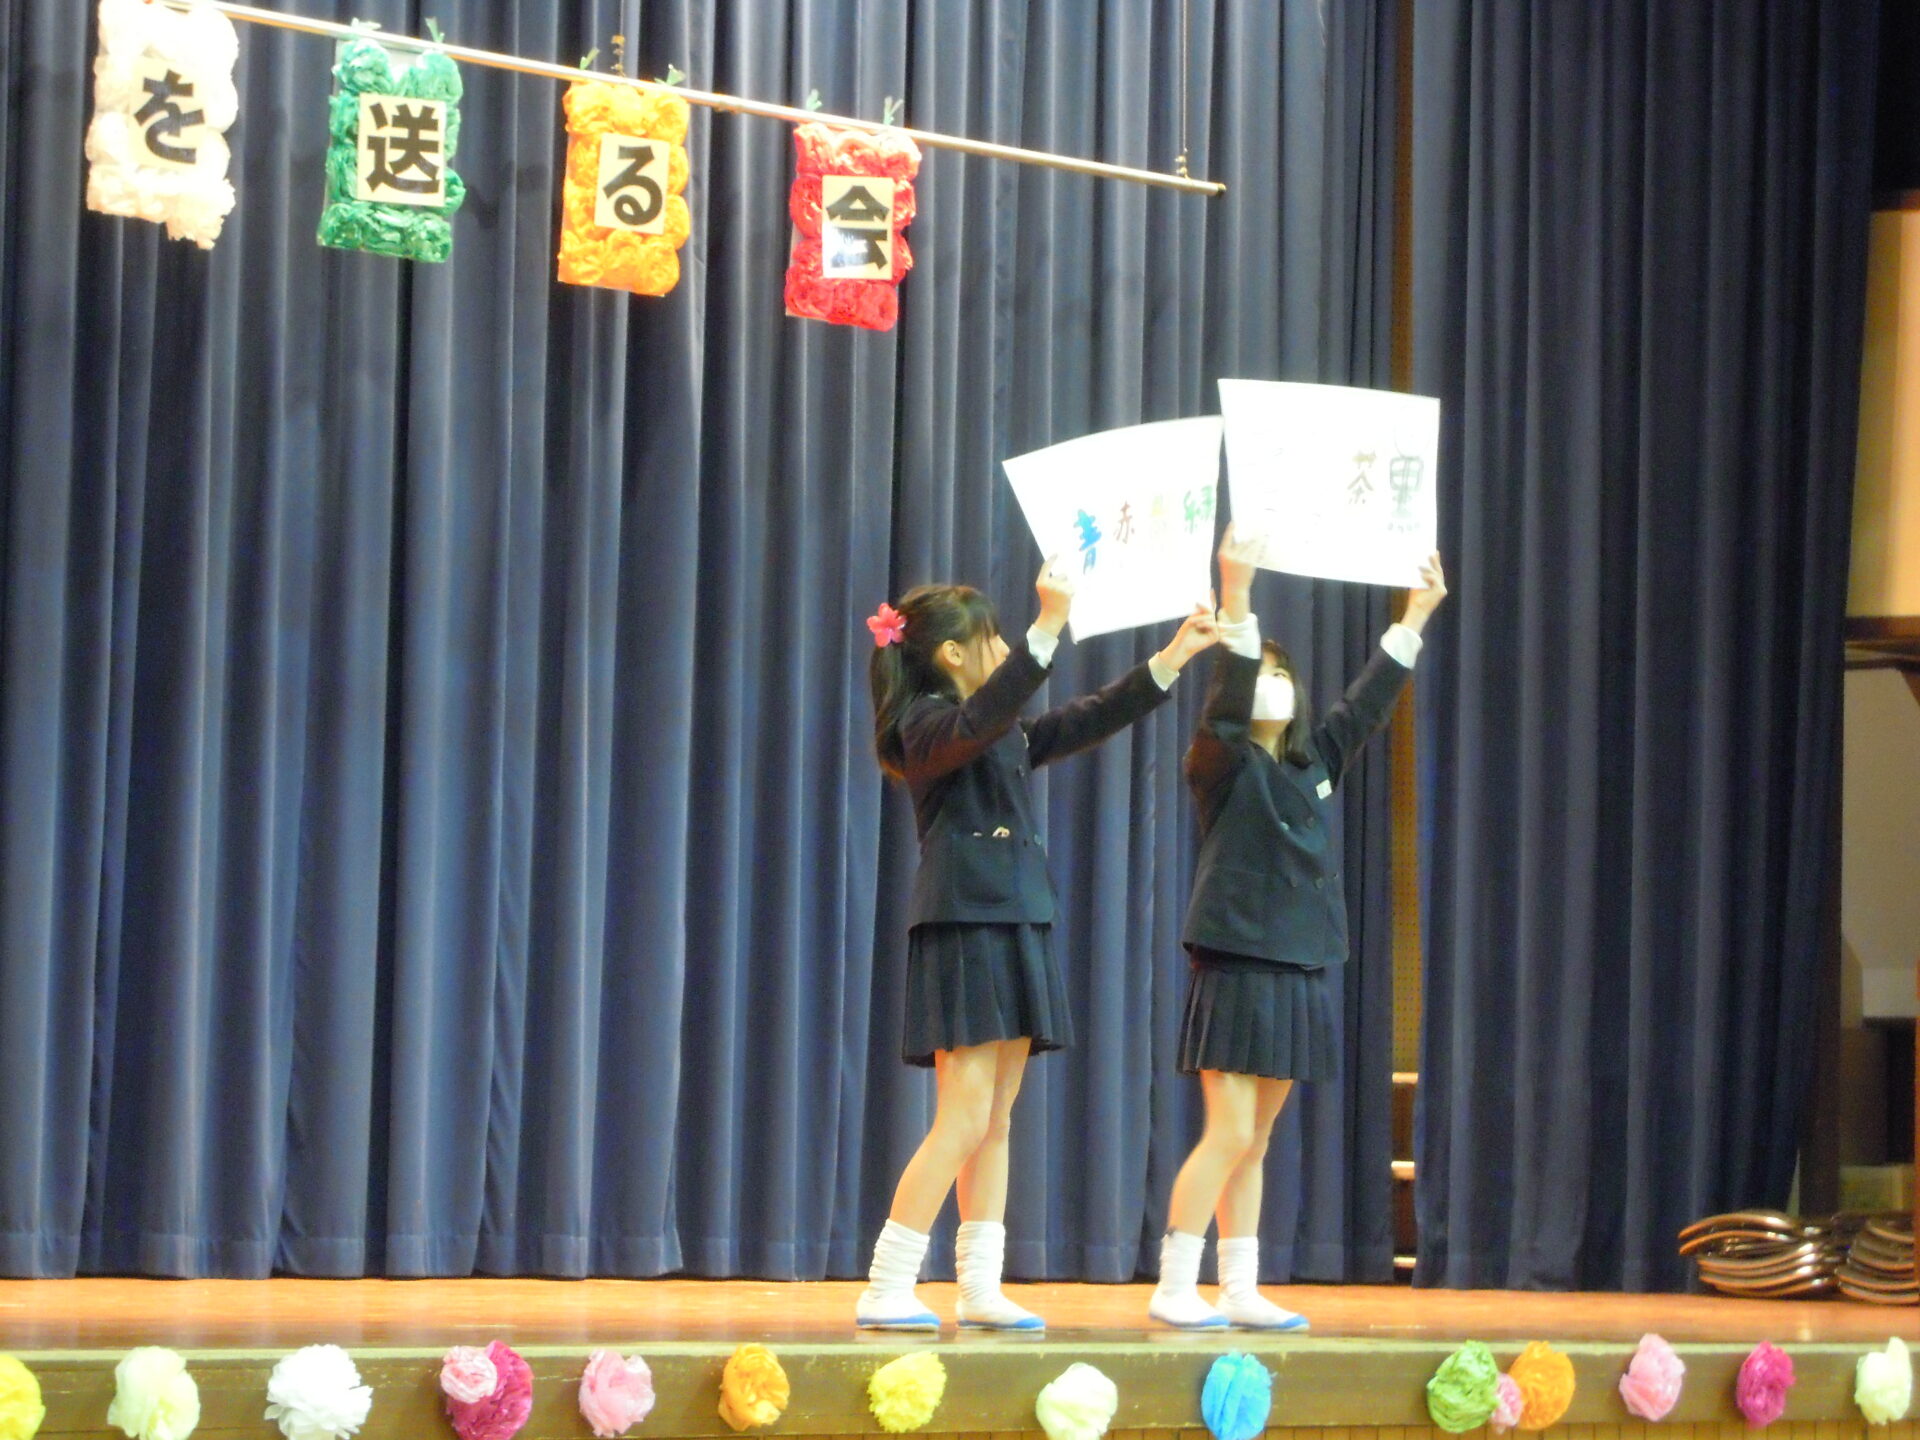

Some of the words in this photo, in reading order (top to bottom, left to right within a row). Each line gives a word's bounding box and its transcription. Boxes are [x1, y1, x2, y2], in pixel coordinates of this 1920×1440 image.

[135, 70, 205, 164] を
[366, 102, 441, 194] 送
[603, 146, 664, 226] る
[826, 185, 890, 270] 会
